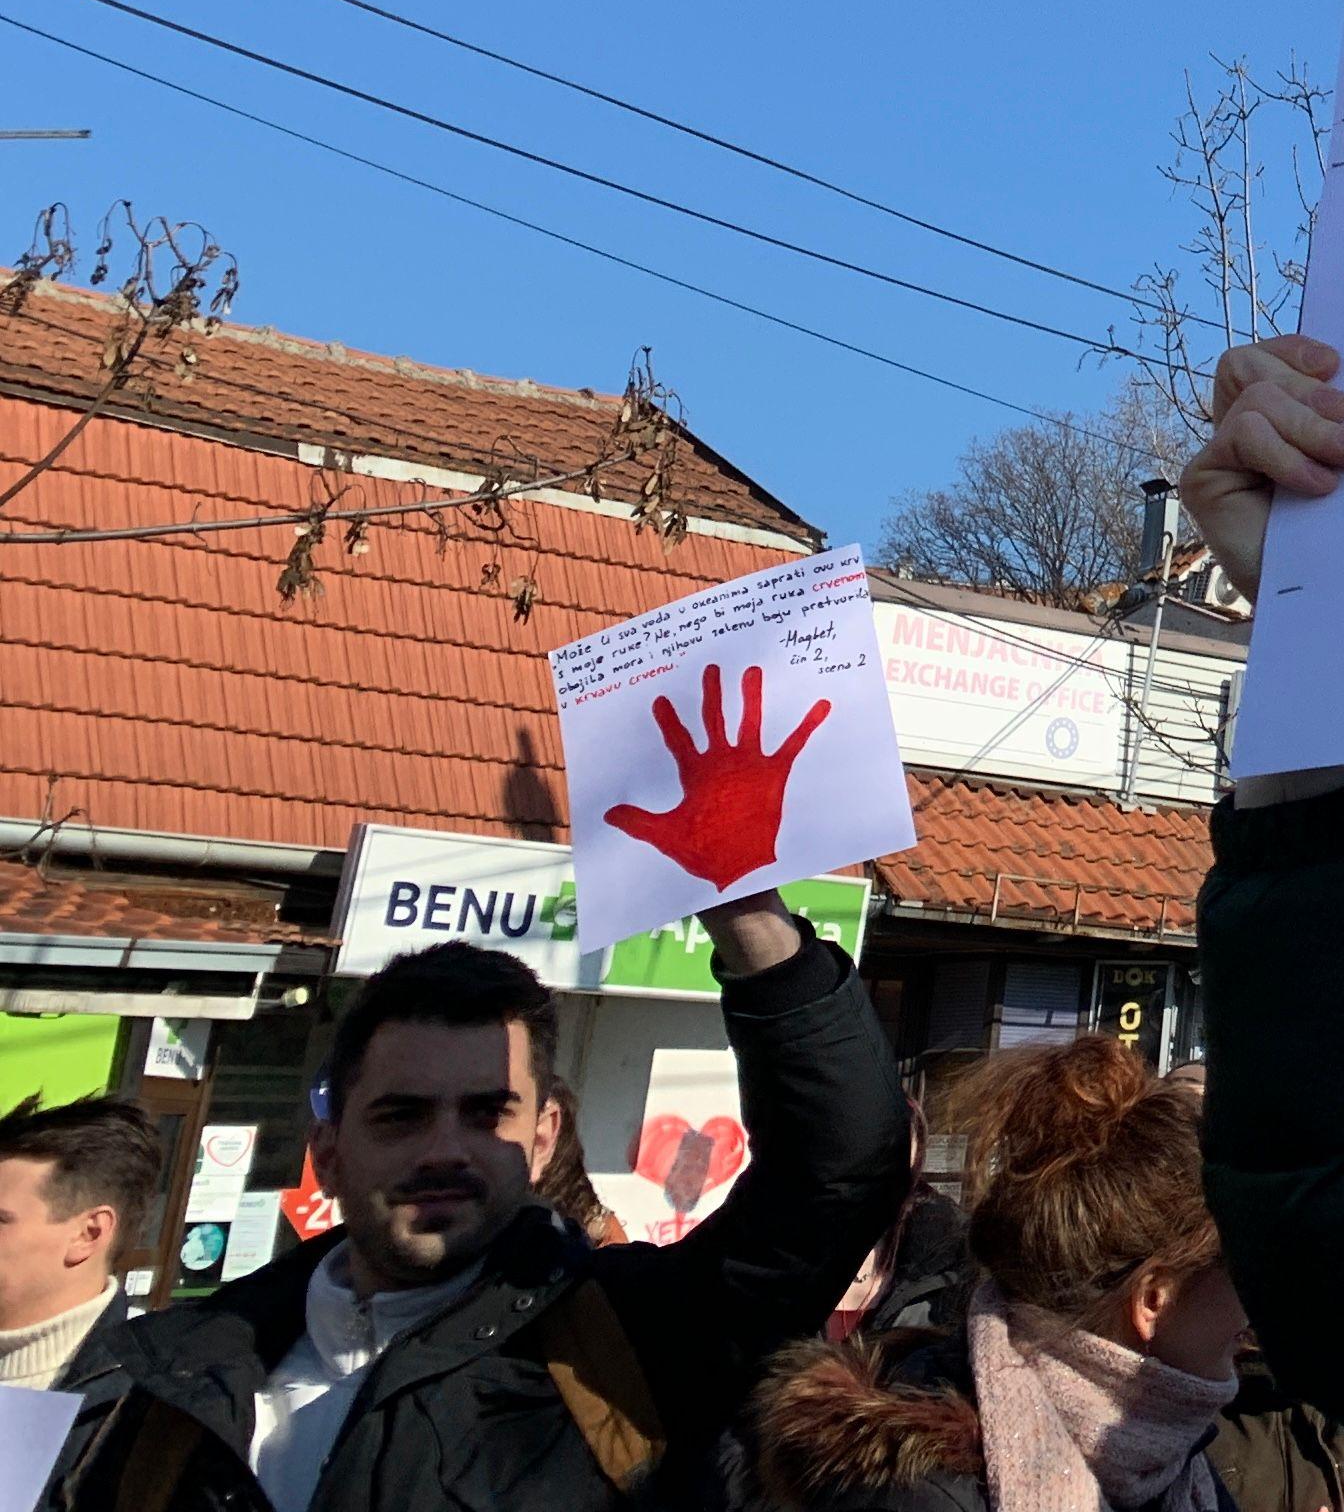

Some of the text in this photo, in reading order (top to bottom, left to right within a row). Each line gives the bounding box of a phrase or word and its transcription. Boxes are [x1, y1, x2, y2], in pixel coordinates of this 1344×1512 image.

[618, 627, 638, 641] sva
[641, 611, 671, 629] voda
[757, 569, 805, 589] saprati
[813, 562, 834, 574] ovu
[733, 597, 764, 614] moja
[771, 588, 805, 602] ruka
[811, 571, 866, 593] crvenom
[612, 657, 644, 674] mora
[885, 657, 1105, 714] EXCHANGE OFFICE
[384, 881, 537, 938] BENU
